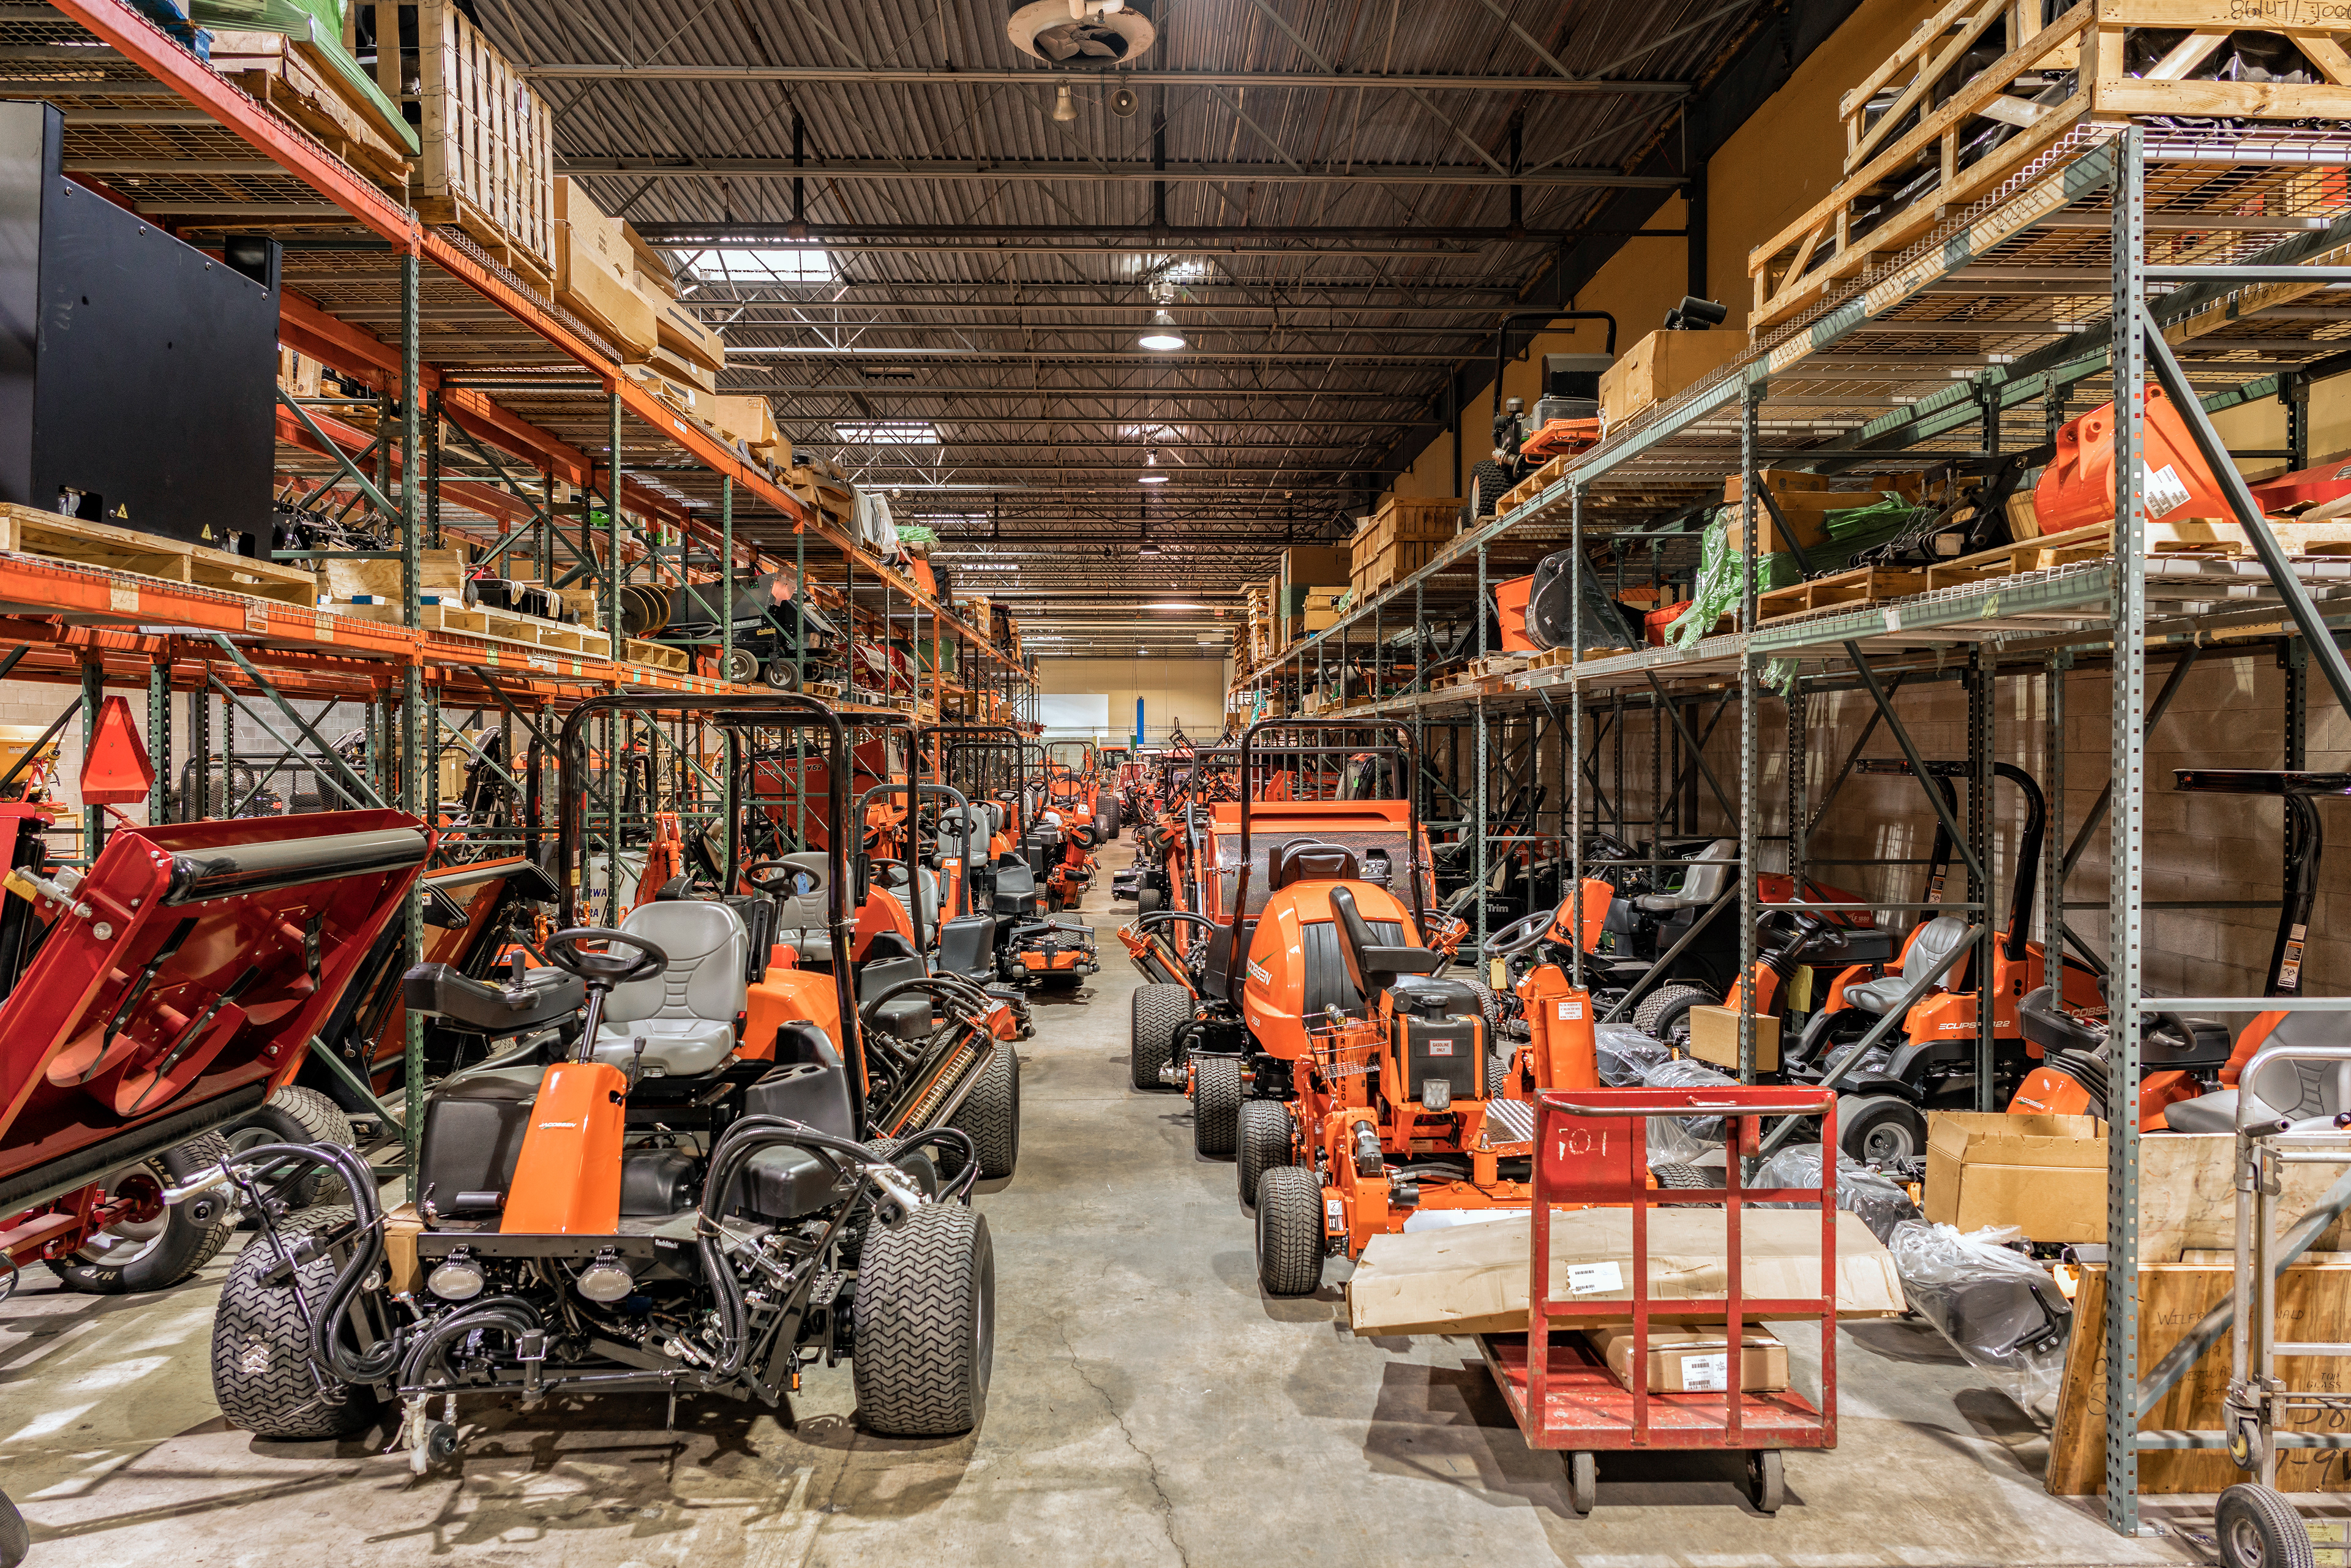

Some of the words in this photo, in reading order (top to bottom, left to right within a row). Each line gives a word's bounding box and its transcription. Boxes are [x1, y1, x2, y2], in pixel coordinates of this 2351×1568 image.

[1486, 904, 1509, 912] Trim
[2016, 1096, 2045, 1109] JACOBSEN
[2321, 1371, 2340, 1381] TOP
[2306, 1381, 2342, 1390] GLASS
